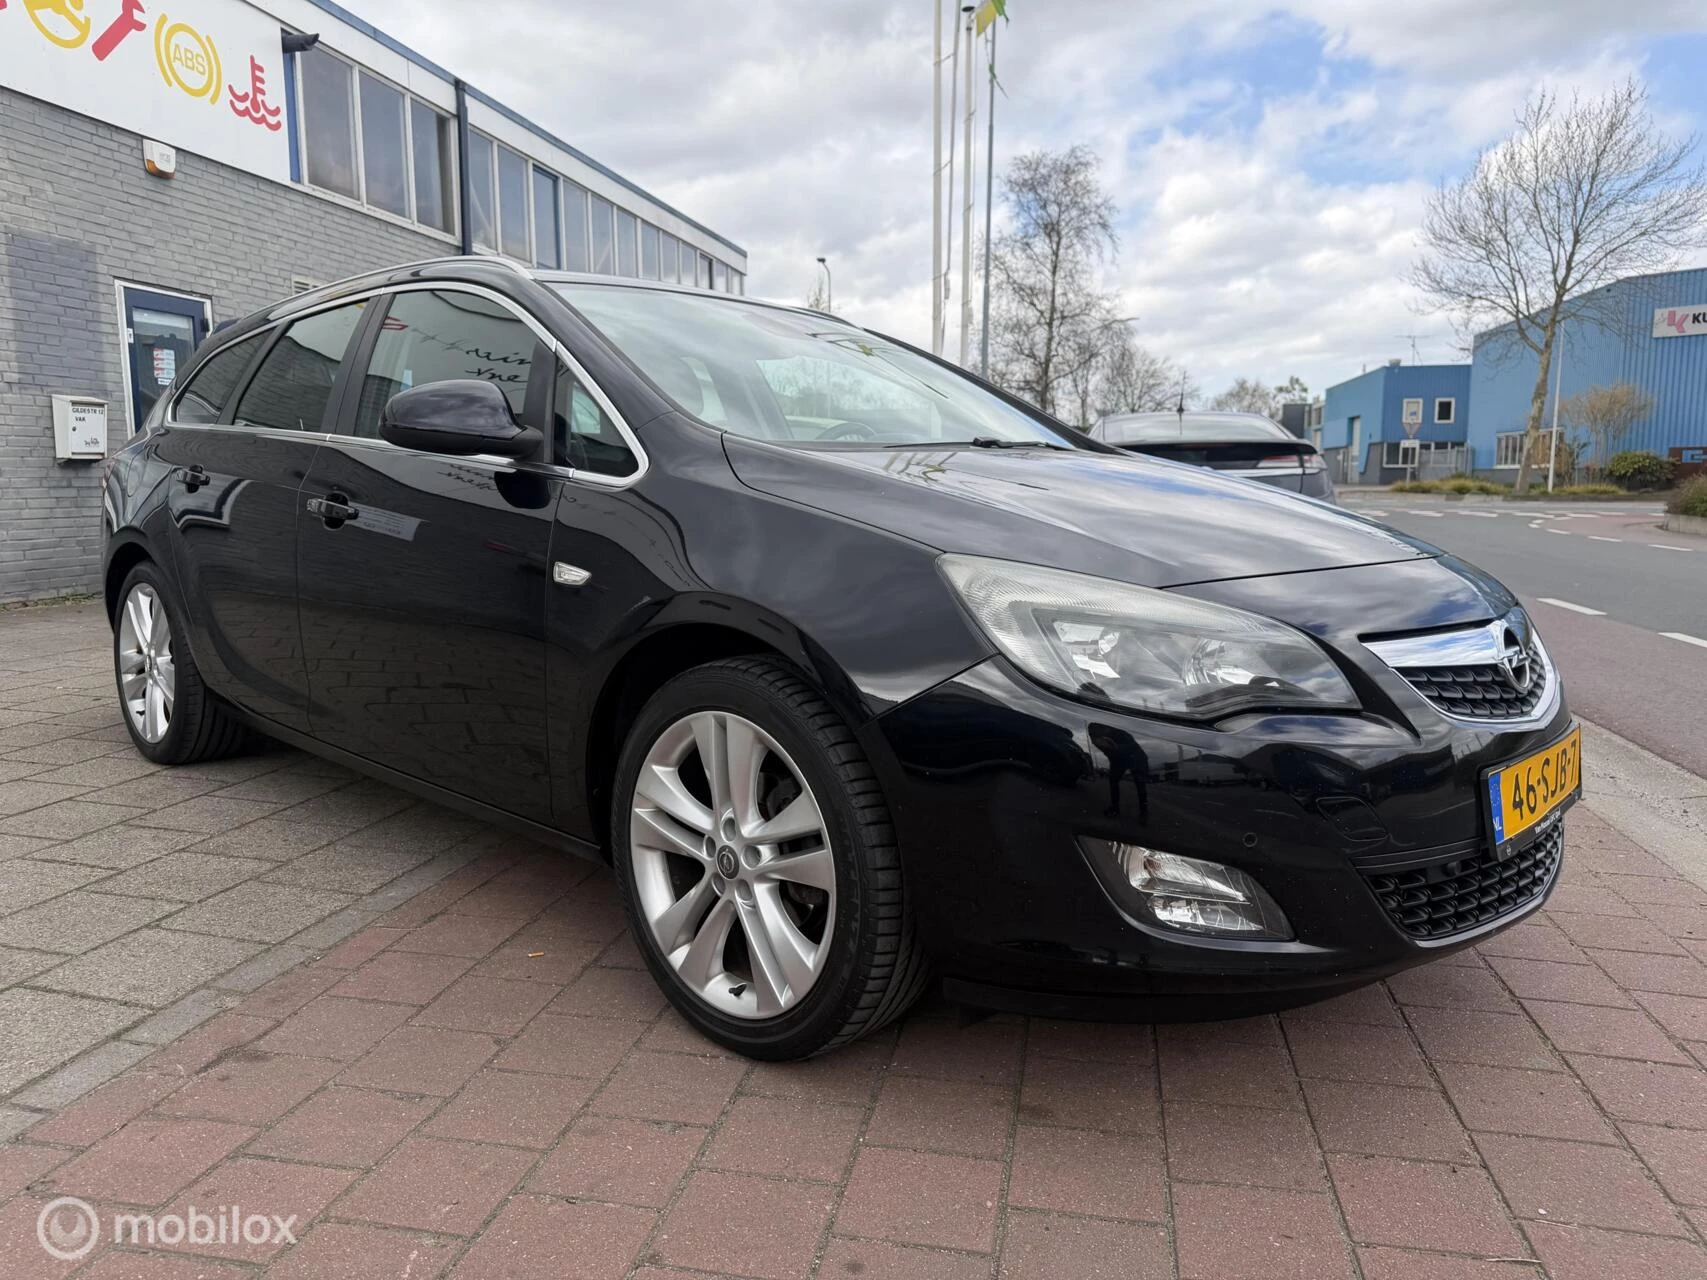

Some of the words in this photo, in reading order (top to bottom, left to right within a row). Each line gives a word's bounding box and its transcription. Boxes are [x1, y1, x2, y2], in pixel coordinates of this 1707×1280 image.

[172, 43, 207, 76] ABS
[1512, 738, 1577, 821] 46-SJB-7
[1493, 818, 1502, 832] NL
